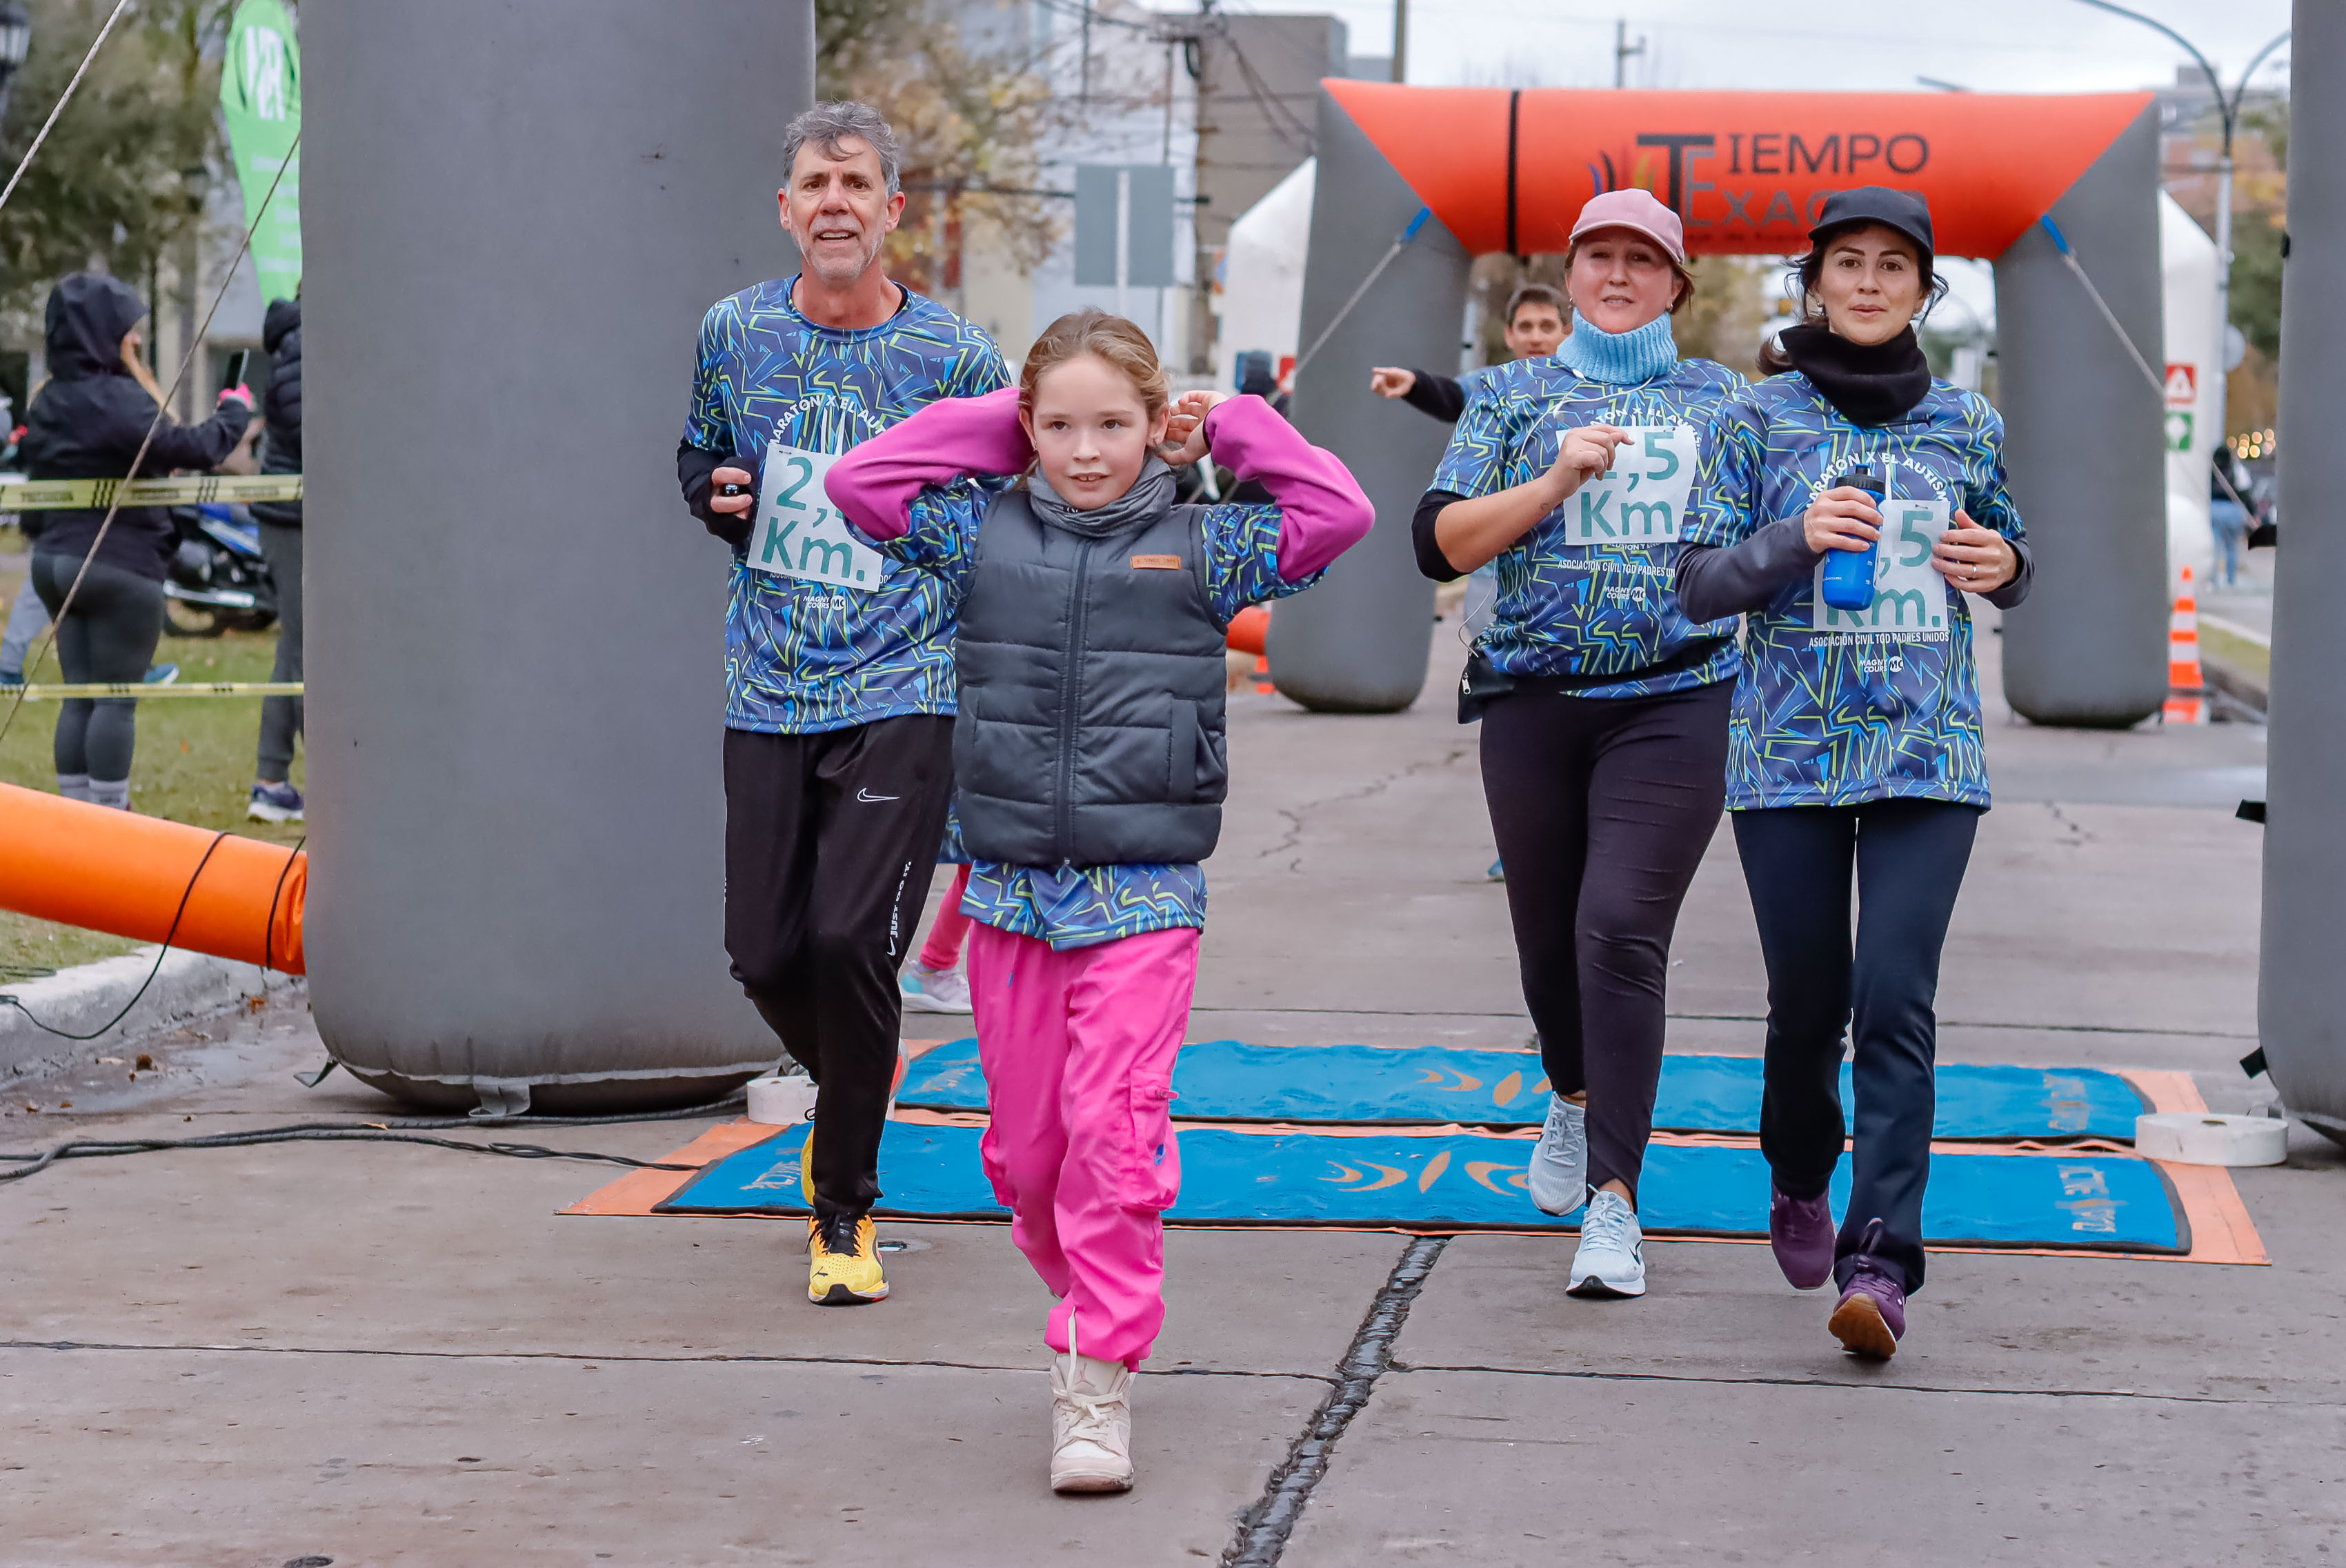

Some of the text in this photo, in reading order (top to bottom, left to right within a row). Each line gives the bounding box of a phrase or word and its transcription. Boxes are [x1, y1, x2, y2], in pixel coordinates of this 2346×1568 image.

[826, 395, 837, 407] X
[840, 398, 855, 413] EL
[1648, 408, 1664, 417] EL
[1591, 432, 1679, 493] ,5
[1866, 451, 1877, 464] X
[1882, 453, 1898, 464] EL
[776, 457, 844, 528] 2,
[761, 517, 864, 582] Km.
[1558, 559, 1601, 572] ASOCIACIÓN
[1603, 562, 1621, 573] CIVIL
[1622, 563, 1637, 574] TGD
[1638, 566, 1665, 577] PADRES
[1855, 634, 1873, 645] CIVIL
[1875, 633, 1891, 644] TGD
[1892, 633, 1920, 643] PADRES
[1922, 632, 1949, 642] UNIDOS
